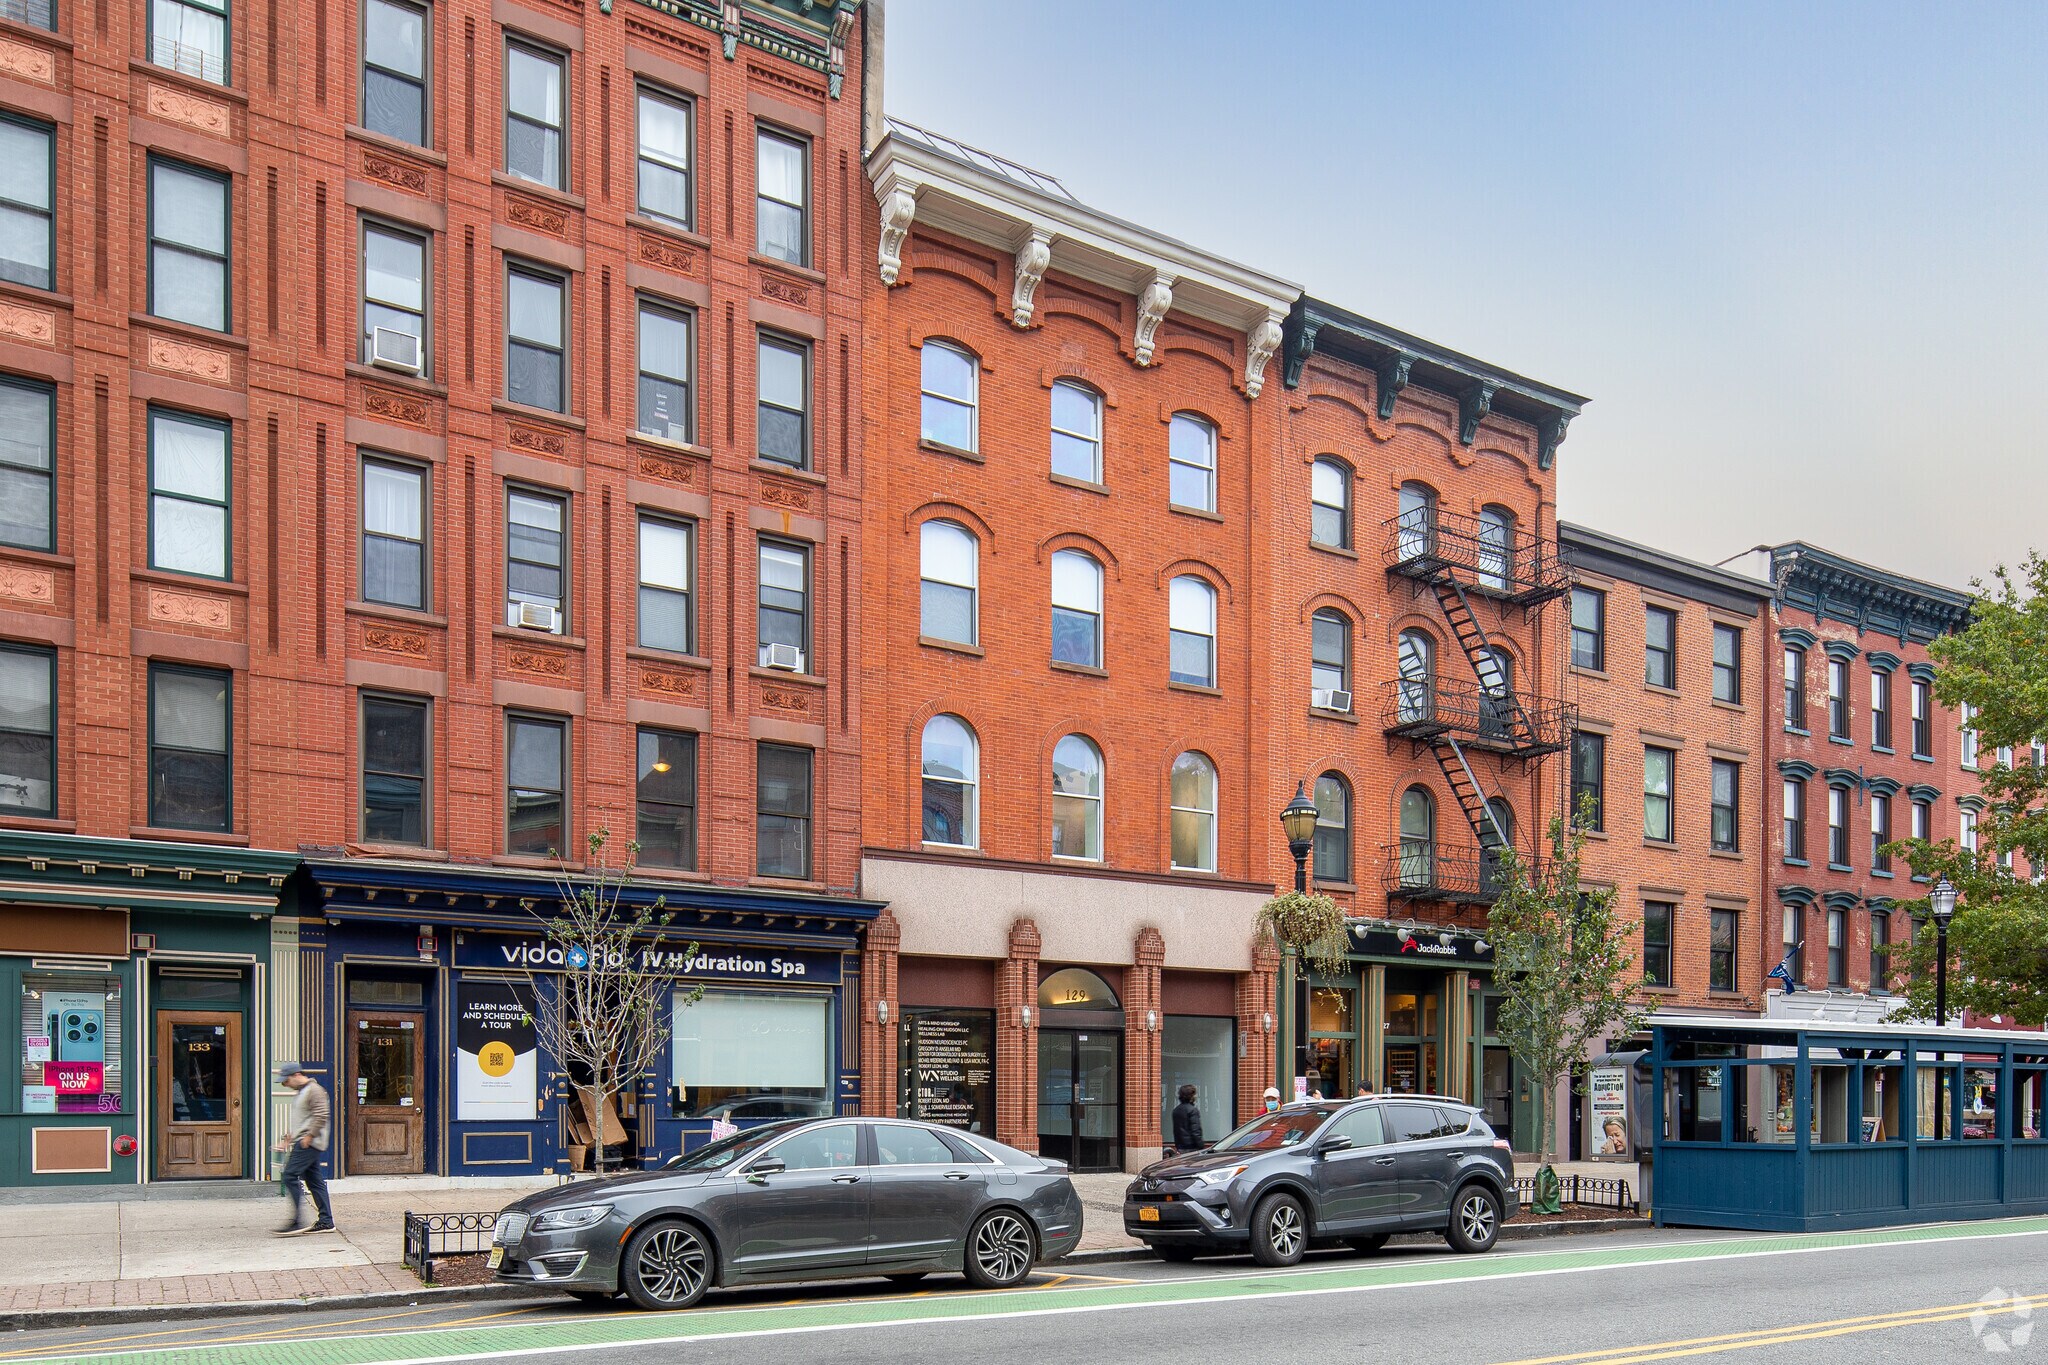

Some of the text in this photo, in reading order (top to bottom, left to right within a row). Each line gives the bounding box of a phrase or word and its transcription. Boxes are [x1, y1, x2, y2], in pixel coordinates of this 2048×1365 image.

[1417, 944, 1457, 955] JackRabbit
[501, 941, 564, 965] vida
[668, 952, 767, 973] Hydration
[771, 957, 806, 978] Spa
[1065, 989, 1086, 1001] 129
[469, 1003, 524, 1012] LEARN MORE
[483, 1012, 526, 1021] SCHEDULE
[481, 1021, 512, 1029] A TOUR
[377, 1038, 393, 1046] 131
[189, 1042, 210, 1052] 133
[48, 1065, 75, 1073] iPhone
[59, 1072, 90, 1081] ON US
[61, 1080, 87, 1089] NOW
[1594, 1082, 1624, 1092] ADDICTION
